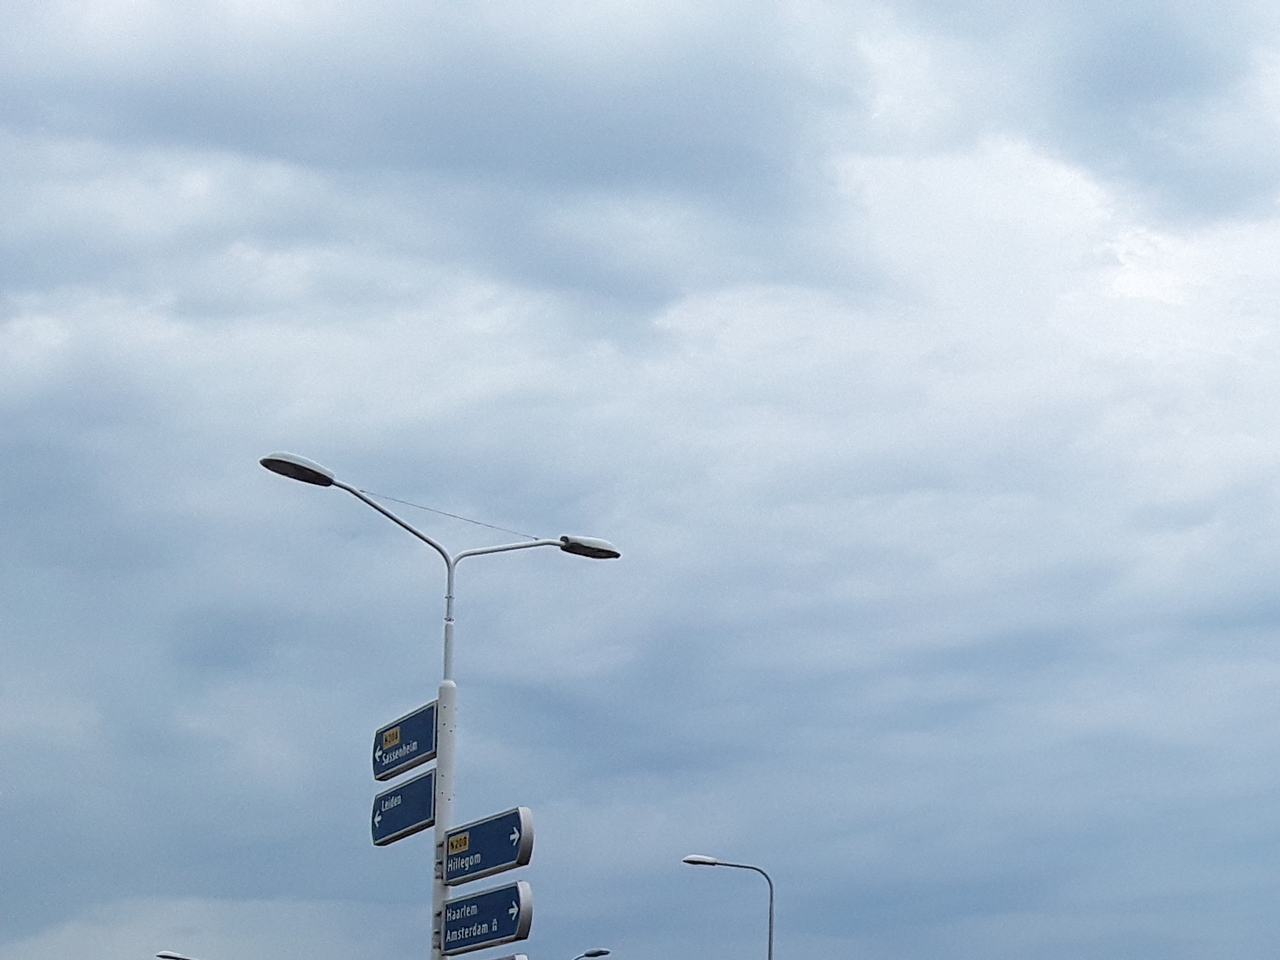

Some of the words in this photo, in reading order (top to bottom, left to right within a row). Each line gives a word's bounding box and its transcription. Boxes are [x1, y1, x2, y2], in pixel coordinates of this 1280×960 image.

[382, 740, 418, 766] Sassenheim
[381, 795, 402, 812] Leiden
[447, 853, 481, 872] Hillegom
[446, 904, 478, 922] Haarlem
[446, 923, 489, 942] Amsterdam
